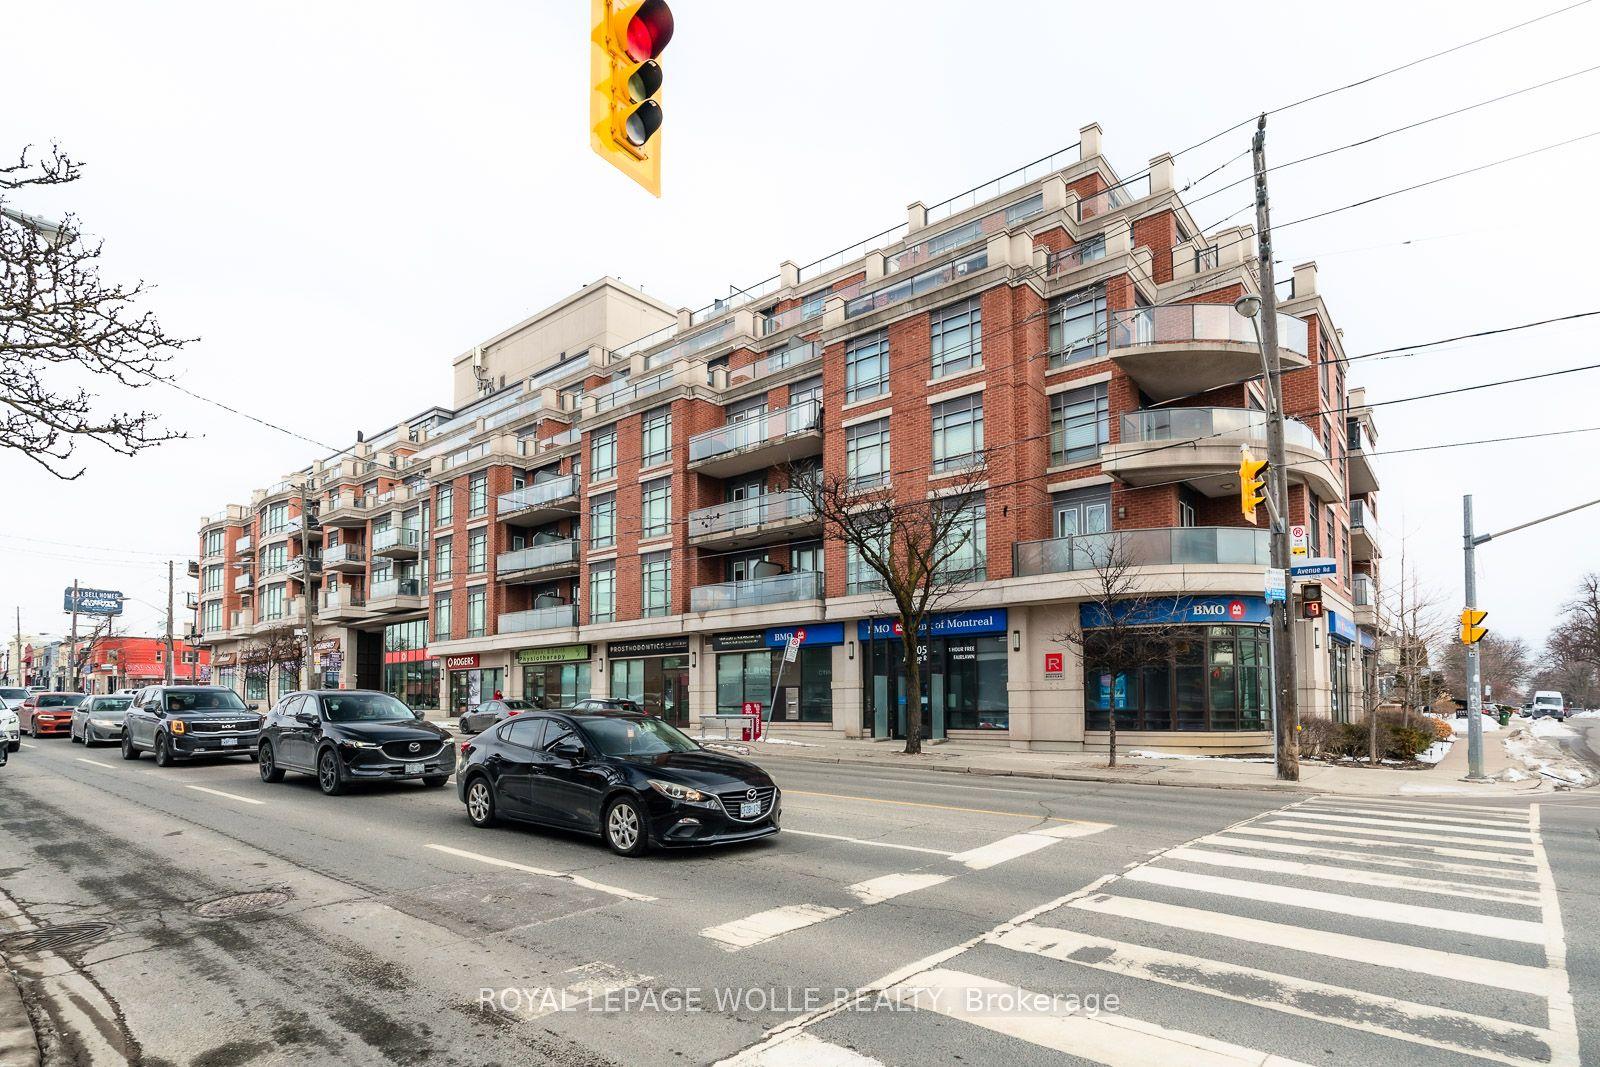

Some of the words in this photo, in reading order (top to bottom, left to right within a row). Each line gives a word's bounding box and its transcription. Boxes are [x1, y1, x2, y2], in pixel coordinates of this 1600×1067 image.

[1193, 604, 1225, 615] BMO
[1311, 603, 1319, 615] 9
[868, 624, 890, 634] MO
[935, 620, 945, 629] of
[947, 616, 993, 629] Montreal
[774, 632, 793, 642] BMO
[610, 643, 664, 653] PROSTHODONTICS
[453, 657, 474, 666] ROGERS
[519, 654, 566, 662] Physiotherapy
[1048, 658, 1060, 670] R
